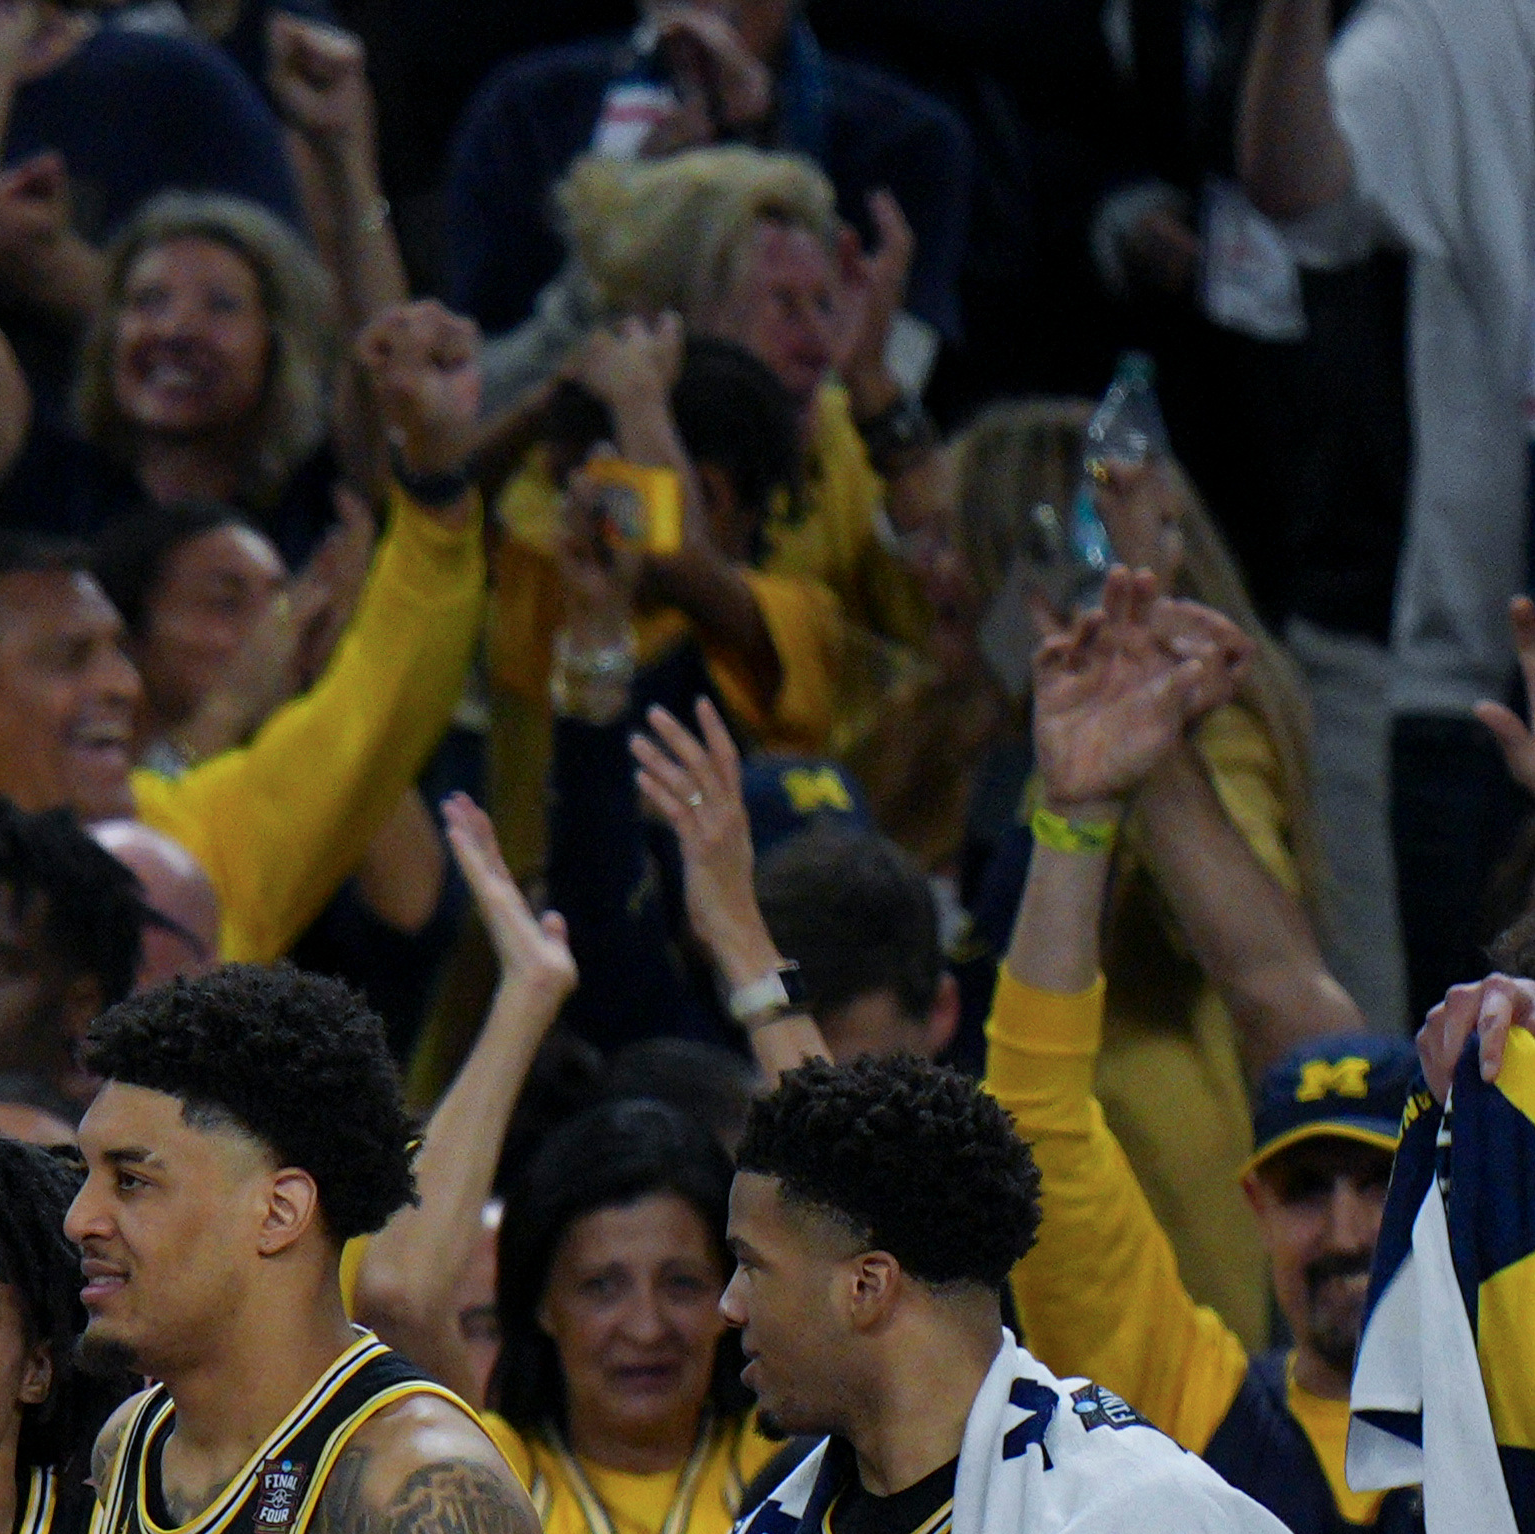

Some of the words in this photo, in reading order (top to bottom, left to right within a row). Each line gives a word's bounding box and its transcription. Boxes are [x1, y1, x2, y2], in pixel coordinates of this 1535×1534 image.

[1296, 1056, 1371, 1102] M
[264, 1473, 299, 1492] FINAL
[259, 1506, 290, 1524] FOUR
